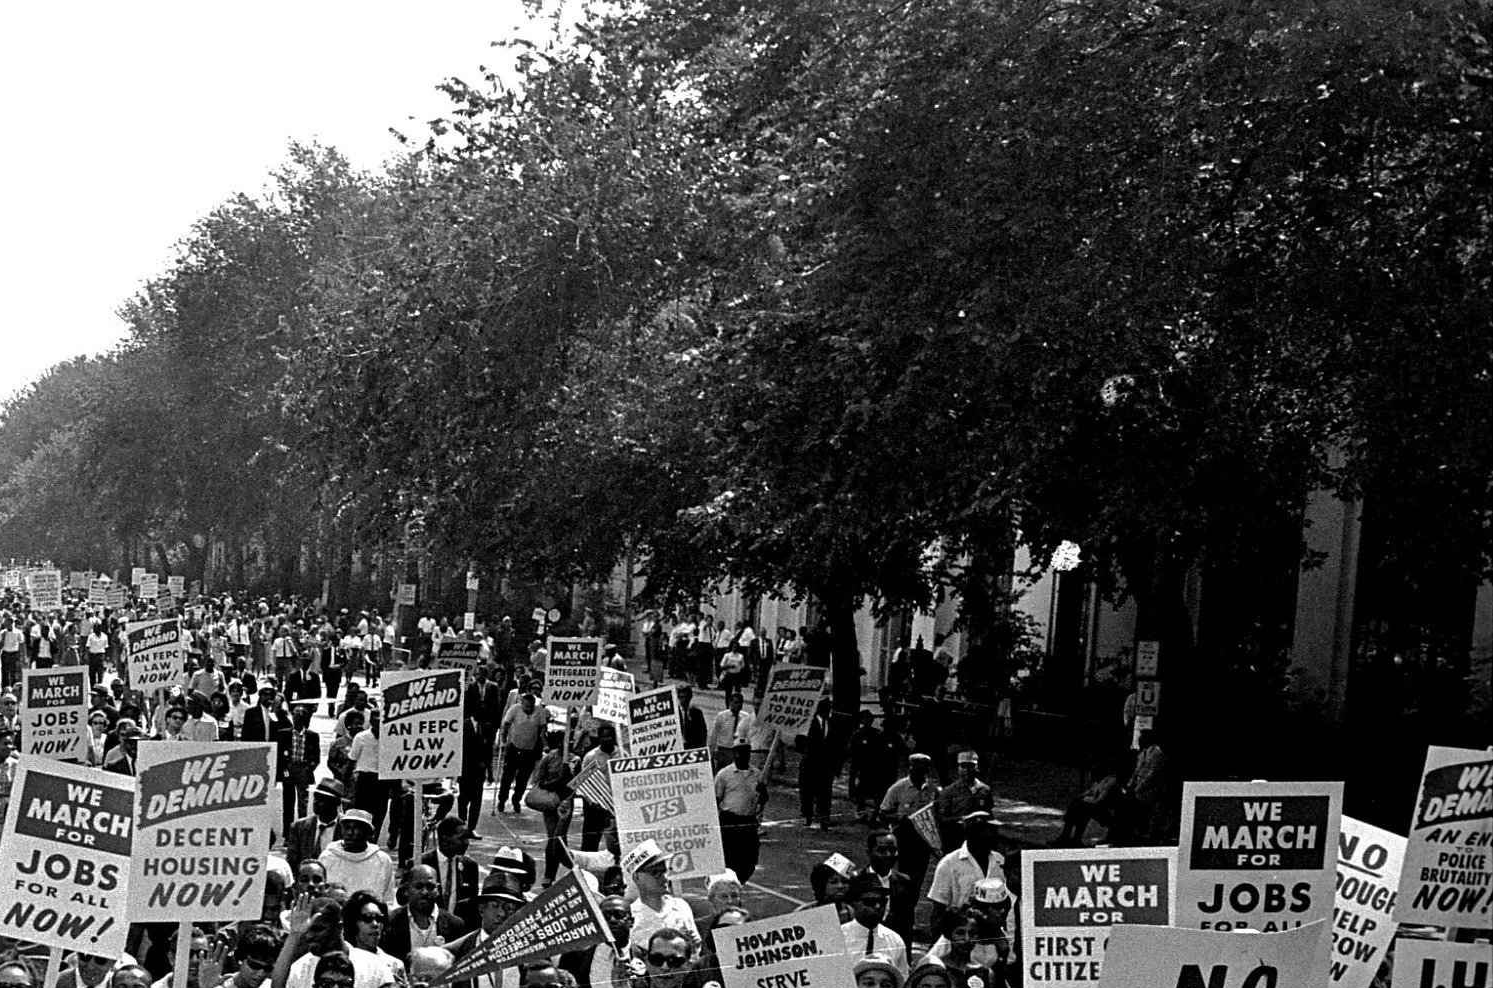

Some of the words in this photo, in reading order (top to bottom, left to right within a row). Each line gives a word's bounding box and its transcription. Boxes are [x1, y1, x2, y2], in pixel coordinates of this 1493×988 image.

[143, 624, 163, 639] WE
[133, 652, 150, 664] AN
[152, 649, 180, 661] FEPC
[144, 661, 172, 672] LAW
[553, 651, 595, 661] MARCH
[47, 675, 66, 687] WE
[137, 669, 179, 685] NOW!
[549, 667, 598, 677] INTEGRATED
[31, 684, 81, 701] MARCH
[407, 676, 438, 698] WE
[549, 678, 596, 688] SCHOOLS
[387, 687, 458, 719] DEMAND
[550, 688, 595, 701] NOW!
[30, 710, 80, 728] JOBS
[633, 700, 672, 719] MARCH
[387, 721, 413, 737] AN
[418, 719, 460, 735] FEPC
[29, 735, 81, 756] NOW!
[403, 737, 446, 751] LAW
[180, 753, 232, 786] WE
[391, 749, 456, 771] NOW!
[613, 756, 651, 772] UAW
[66, 782, 104, 808] WE
[145, 773, 266, 820] DEMAND
[26, 797, 132, 838] MARCH
[644, 800, 681, 823] YES
[1242, 801, 1283, 822] WE
[55, 826, 97, 847] FOR
[155, 826, 254, 848] DECENT
[1200, 824, 1318, 850] MARCH
[1424, 828, 1462, 844] AN
[1236, 853, 1282, 867] FOR
[1437, 851, 1487, 870] POLICE
[1454, 846, 1475, 854] TO
[15, 848, 120, 891] JOBS
[142, 855, 261, 877] HOUSING
[1079, 863, 1122, 883] WE
[1419, 866, 1493, 887] BRUTALITY
[13, 878, 59, 899] FOR
[68, 891, 110, 910] ALL
[147, 876, 254, 910] NOW!
[564, 884, 580, 898] WE
[1043, 884, 1159, 909] MARCH
[1196, 881, 1312, 914] JOBS
[543, 893, 568, 912] WANT
[566, 896, 583, 911] AND
[2, 901, 115, 944] NOW!
[570, 908, 590, 925] FOR
[1078, 910, 1125, 924] FOR
[491, 909, 543, 947] FREEDOM
[536, 916, 569, 941] JOBS
[556, 921, 598, 945] MARCH
[734, 924, 807, 953] HOWARD
[487, 938, 530, 962] FREEDOM
[495, 941, 548, 964] WASHINGTON
[1034, 935, 1097, 957] FIRST
